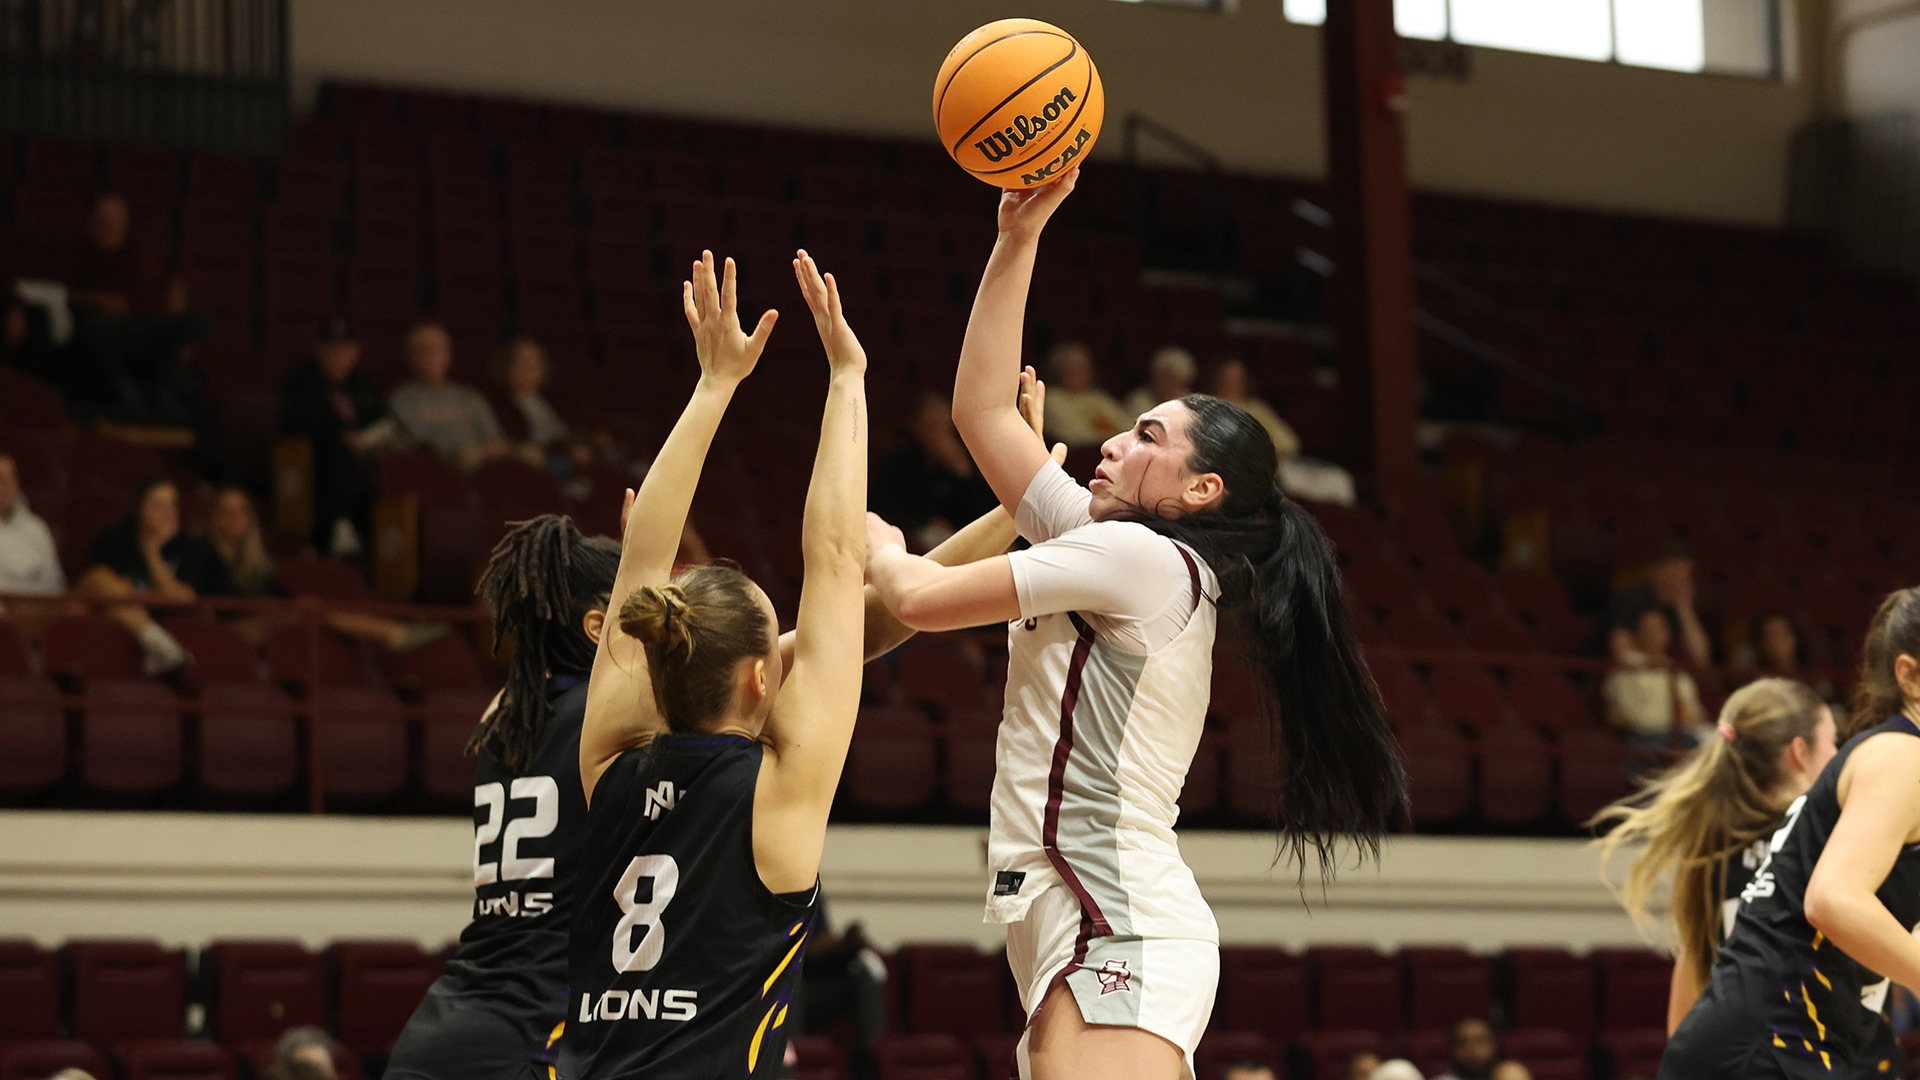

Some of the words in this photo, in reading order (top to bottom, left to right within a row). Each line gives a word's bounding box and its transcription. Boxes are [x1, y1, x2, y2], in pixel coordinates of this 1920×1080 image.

[975, 86, 1077, 162] Wilson
[1021, 128, 1091, 185] NCAA
[474, 775, 559, 888] 22
[612, 854, 679, 974] 8
